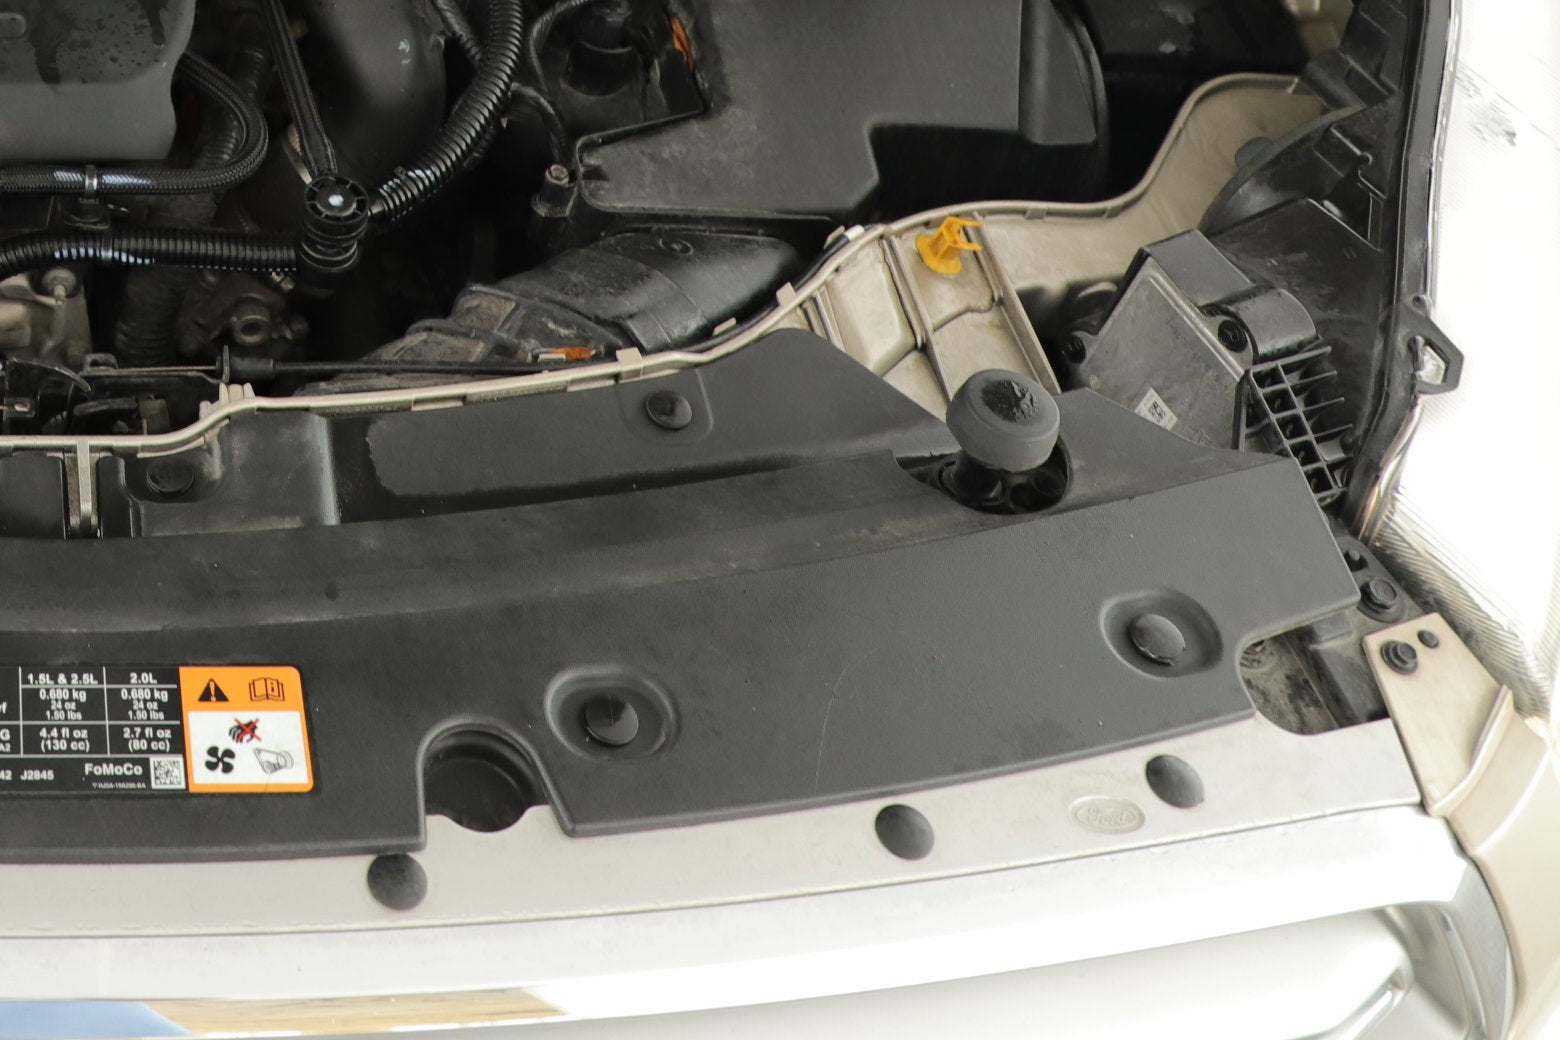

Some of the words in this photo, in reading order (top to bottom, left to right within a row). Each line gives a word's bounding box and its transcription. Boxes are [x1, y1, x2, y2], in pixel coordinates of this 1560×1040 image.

[28, 673, 54, 684] 1.5L
[58, 673, 67, 684] &
[71, 673, 98, 684] 2.5L
[130, 672, 157, 684] 2.0L
[39, 689, 69, 701] 0.680
[72, 689, 86, 702] kg
[121, 689, 151, 701] 0.680
[154, 689, 168, 702] kg
[51, 701, 62, 710] 24
[64, 702, 76, 710] oz
[133, 701, 144, 710] 24
[147, 702, 158, 710] oz
[46, 711, 65, 720] 1.50
[67, 711, 82, 720] lbs
[128, 711, 147, 720] 1.50
[150, 711, 164, 720] lbs
[40, 727, 58, 739] 4.4
[61, 727, 69, 738] fl
[73, 729, 88, 739] oz
[123, 727, 141, 738] 2.7
[145, 727, 153, 738] fl
[157, 729, 171, 738] oz
[41, 739, 67, 752] (130
[70, 739, 90, 752] cc)
[128, 739, 147, 752] (80
[151, 739, 170, 752] cc)
[85, 763, 142, 775] FoMoCo
[20, 770, 54, 780] J2845
